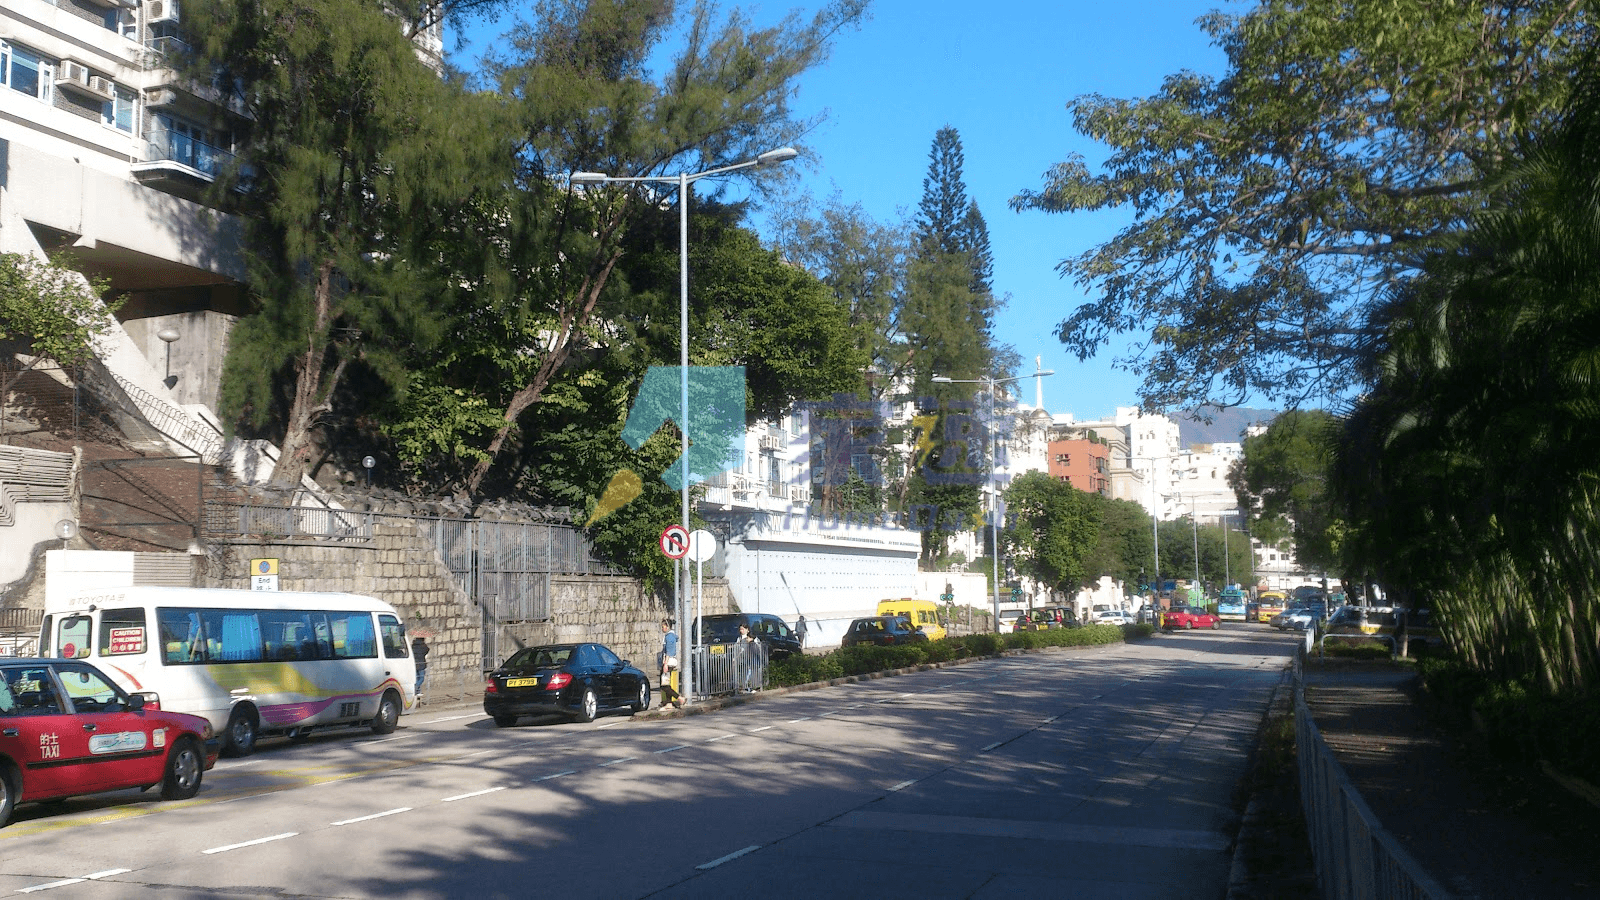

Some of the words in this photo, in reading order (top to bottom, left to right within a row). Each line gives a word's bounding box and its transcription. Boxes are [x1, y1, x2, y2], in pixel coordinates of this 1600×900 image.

[77, 594, 116, 605] TOYOTA
[40, 732, 59, 745] 的士
[40, 745, 60, 759] TAXI
